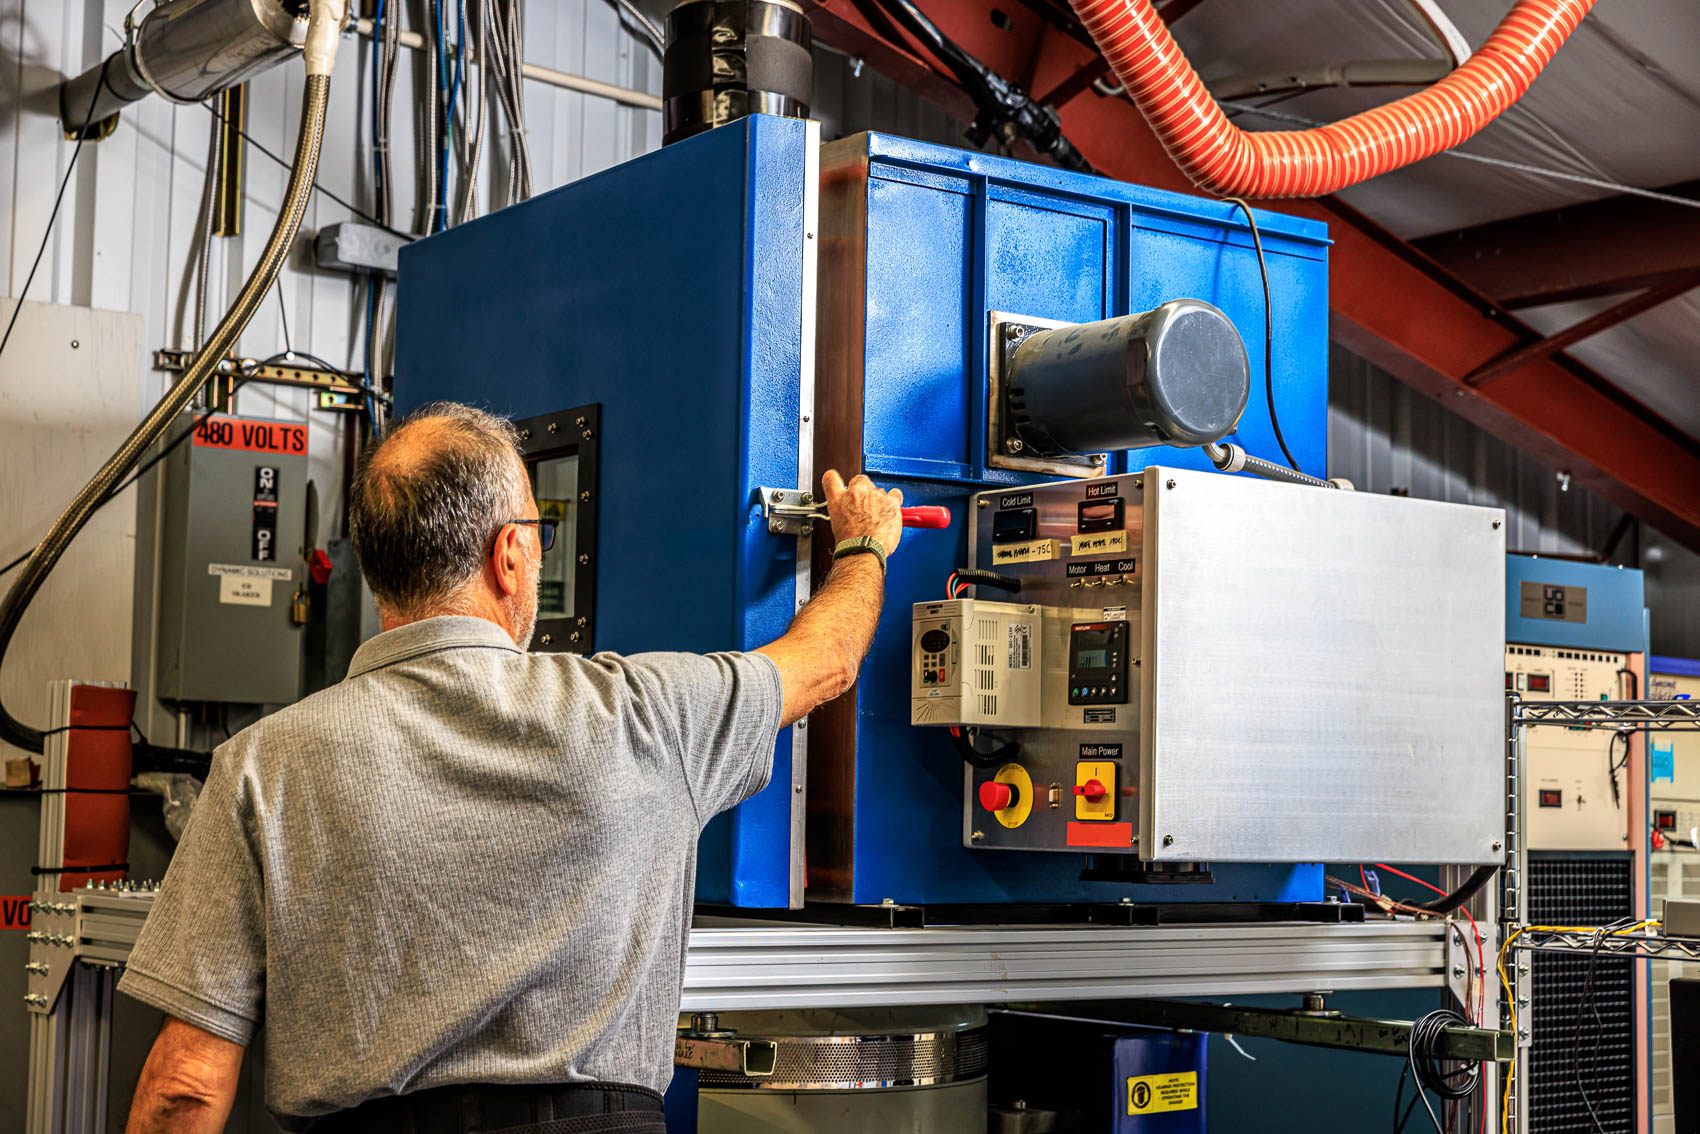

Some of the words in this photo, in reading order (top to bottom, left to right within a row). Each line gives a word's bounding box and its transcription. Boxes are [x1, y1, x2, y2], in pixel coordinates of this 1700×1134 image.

[198, 421, 232, 446] 480
[242, 425, 304, 452] VOLTS
[259, 467, 274, 489] ON
[1088, 487, 1099, 496] Hot
[1100, 484, 1116, 495] Limit
[1002, 497, 1016, 507] Cold
[1016, 495, 1031, 505] Limit
[1068, 565, 1086, 575] Motor
[1094, 563, 1110, 573] Heat
[1118, 560, 1134, 571] Cool
[1081, 746, 1097, 756] Main
[1098, 746, 1118, 756] Power
